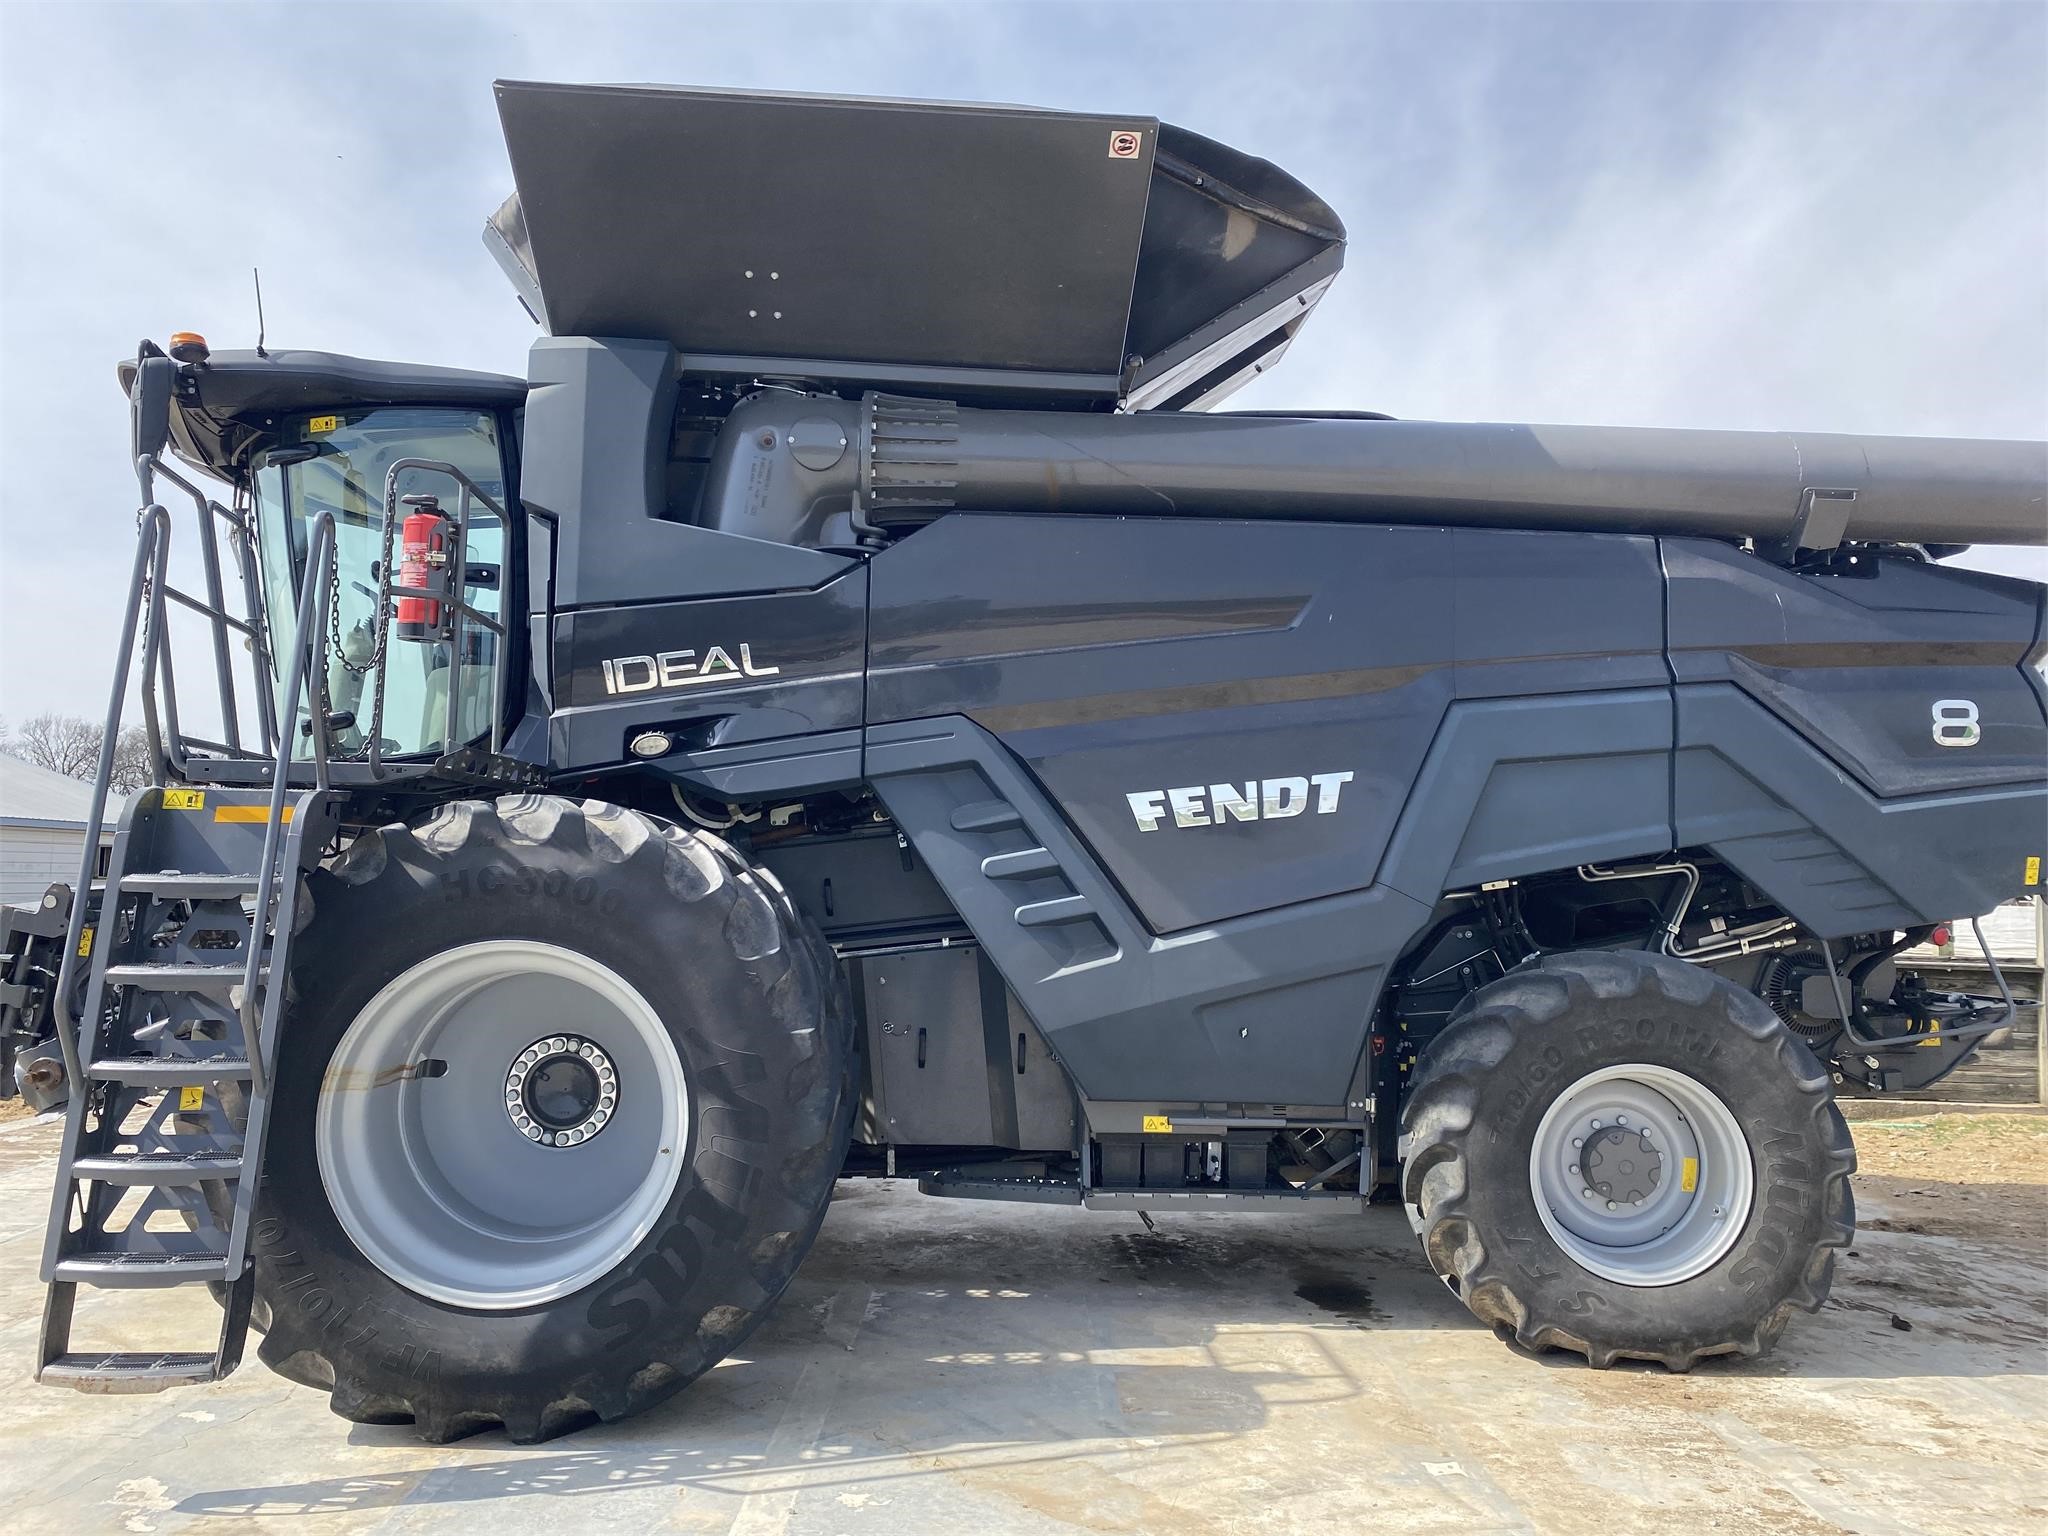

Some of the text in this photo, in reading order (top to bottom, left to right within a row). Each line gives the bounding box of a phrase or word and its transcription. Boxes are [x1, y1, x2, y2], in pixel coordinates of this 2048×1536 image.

[602, 643, 780, 694] IDEAL
[1932, 699, 1981, 747] 8
[1125, 771, 1354, 832] FENDT
